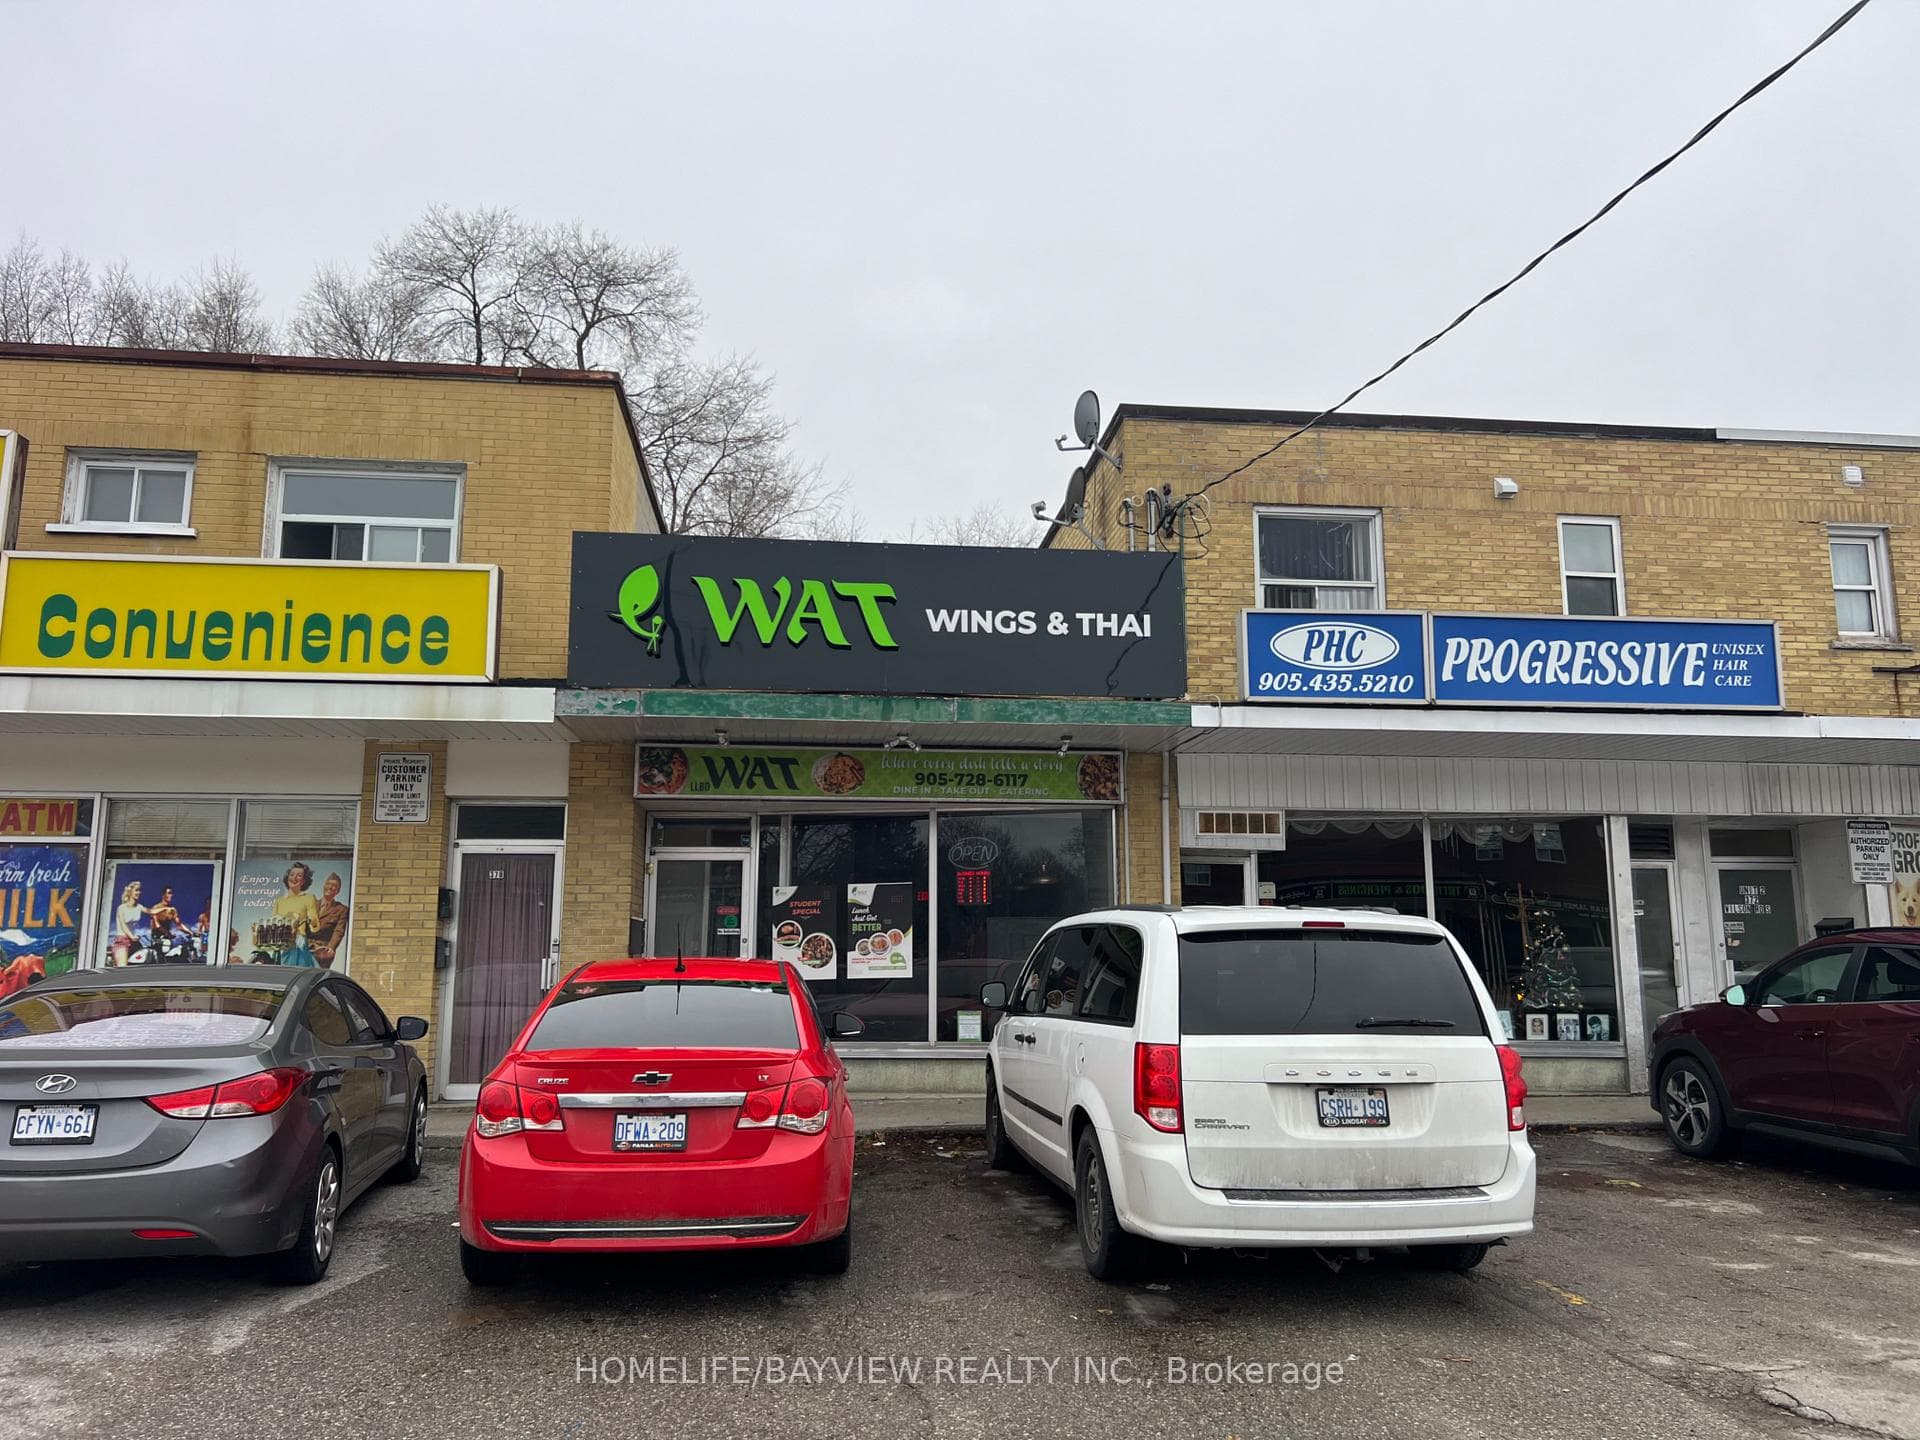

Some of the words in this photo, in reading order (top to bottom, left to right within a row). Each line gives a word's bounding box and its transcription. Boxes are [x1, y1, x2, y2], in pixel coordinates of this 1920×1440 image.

[692, 575, 899, 648] WAT
[37, 593, 450, 666] Convenience
[926, 608, 1036, 634] WINGS
[1046, 612, 1069, 635] &
[1075, 612, 1152, 637] THAI
[1303, 629, 1367, 663] PHC
[1711, 643, 1765, 656] UNISEX
[1441, 637, 1708, 687] PROGRESSIVE
[1713, 659, 1748, 671] HAIR
[1258, 672, 1414, 693] 905.435.5210
[1714, 674, 1752, 687] CARE
[381, 765, 427, 774] CUSTOMER
[702, 755, 800, 790] WAT
[385, 774, 423, 783] PARKING
[393, 783, 414, 791] ONLY
[915, 772, 1028, 787] 905-728-6117
[893, 786, 918, 794] DINE
[921, 786, 931, 794] IN
[942, 786, 967, 794] TAKE
[969, 786, 989, 795] OUT
[1000, 787, 1049, 795] CATERING
[0, 803, 75, 832] ATM
[1850, 837, 1889, 845] AUTHORIZED
[951, 845, 993, 861] OPEN
[26, 860, 71, 887] fresh
[240, 874, 271, 886] Enjoy
[237, 886, 281, 898] beverage
[0, 888, 75, 928] ILK
[852, 923, 882, 931] BETTER
[1321, 1099, 1353, 1118] CSRH
[1362, 1099, 1386, 1118] 199
[16, 1115, 55, 1134] CFYN
[63, 1114, 91, 1133] 661
[616, 1122, 650, 1140] DFWA
[659, 1122, 684, 1140] 209
